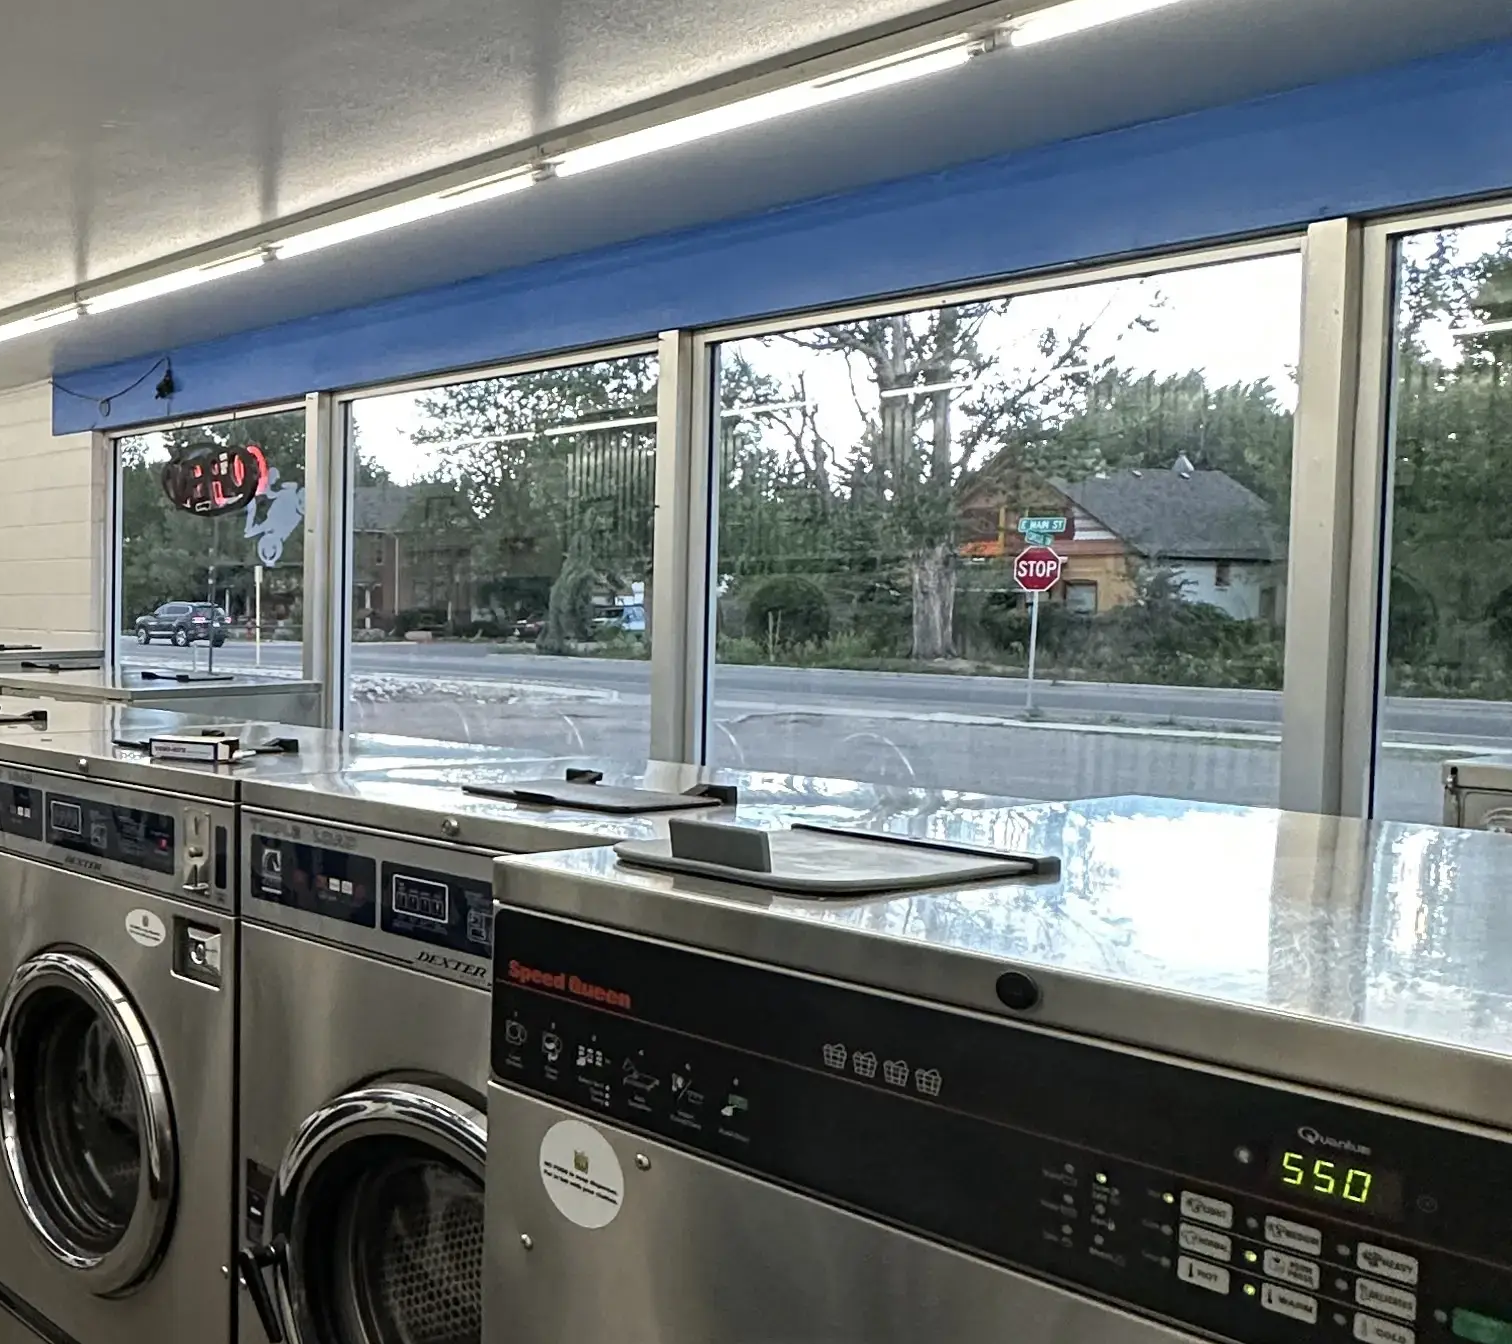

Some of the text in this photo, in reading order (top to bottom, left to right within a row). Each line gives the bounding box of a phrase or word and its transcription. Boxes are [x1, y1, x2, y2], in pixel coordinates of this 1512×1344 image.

[1021, 520, 1063, 529] E MAIN ST
[1018, 560, 1057, 577] STOP
[416, 950, 487, 978] DEXTER
[509, 959, 631, 1009] Speed Queen
[1282, 1152, 1372, 1203] 550
[1375, 1328, 1407, 1344] COLD
